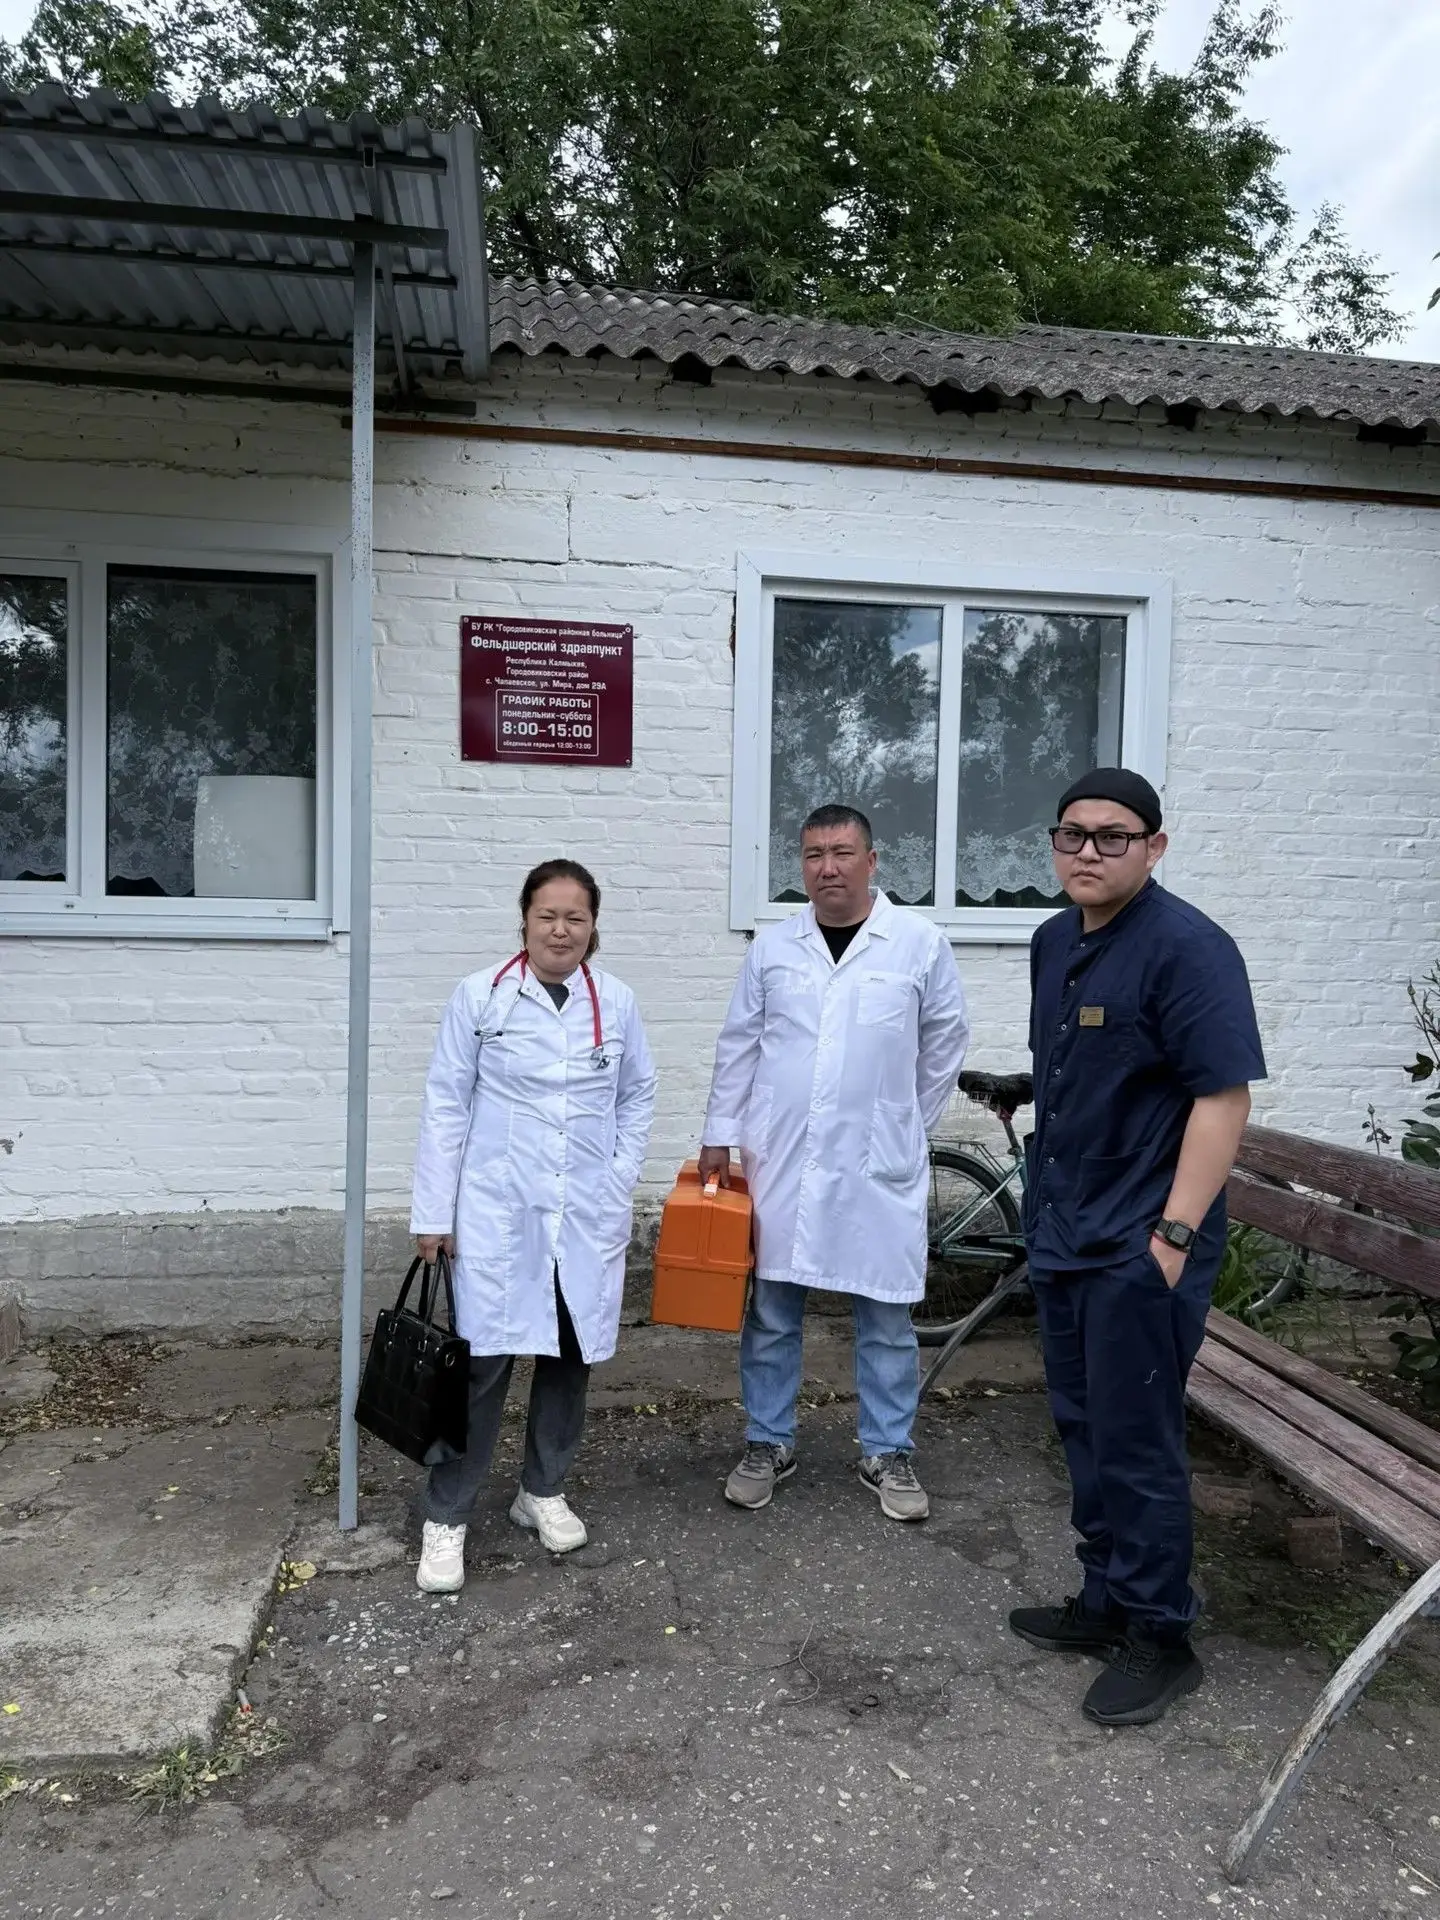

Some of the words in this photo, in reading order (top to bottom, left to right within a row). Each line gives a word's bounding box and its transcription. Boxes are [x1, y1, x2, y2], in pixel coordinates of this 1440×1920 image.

[471, 622, 482, 631] БУ
[483, 622, 494, 632] РК
[558, 628, 590, 637] районная
[592, 629, 626, 640] больница"
[471, 635, 557, 654] Фельдшерский
[560, 643, 623, 658] здравпункт
[505, 656, 547, 667] Республика
[548, 658, 588, 669] Калмыкия,
[506, 667, 567, 677] Городовиковский
[568, 671, 589, 680] район
[540, 681, 550, 689] ул.
[552, 680, 574, 690] Мира,
[502, 694, 546, 706] ГРАФИК
[549, 697, 592, 709] РАБОТЫ
